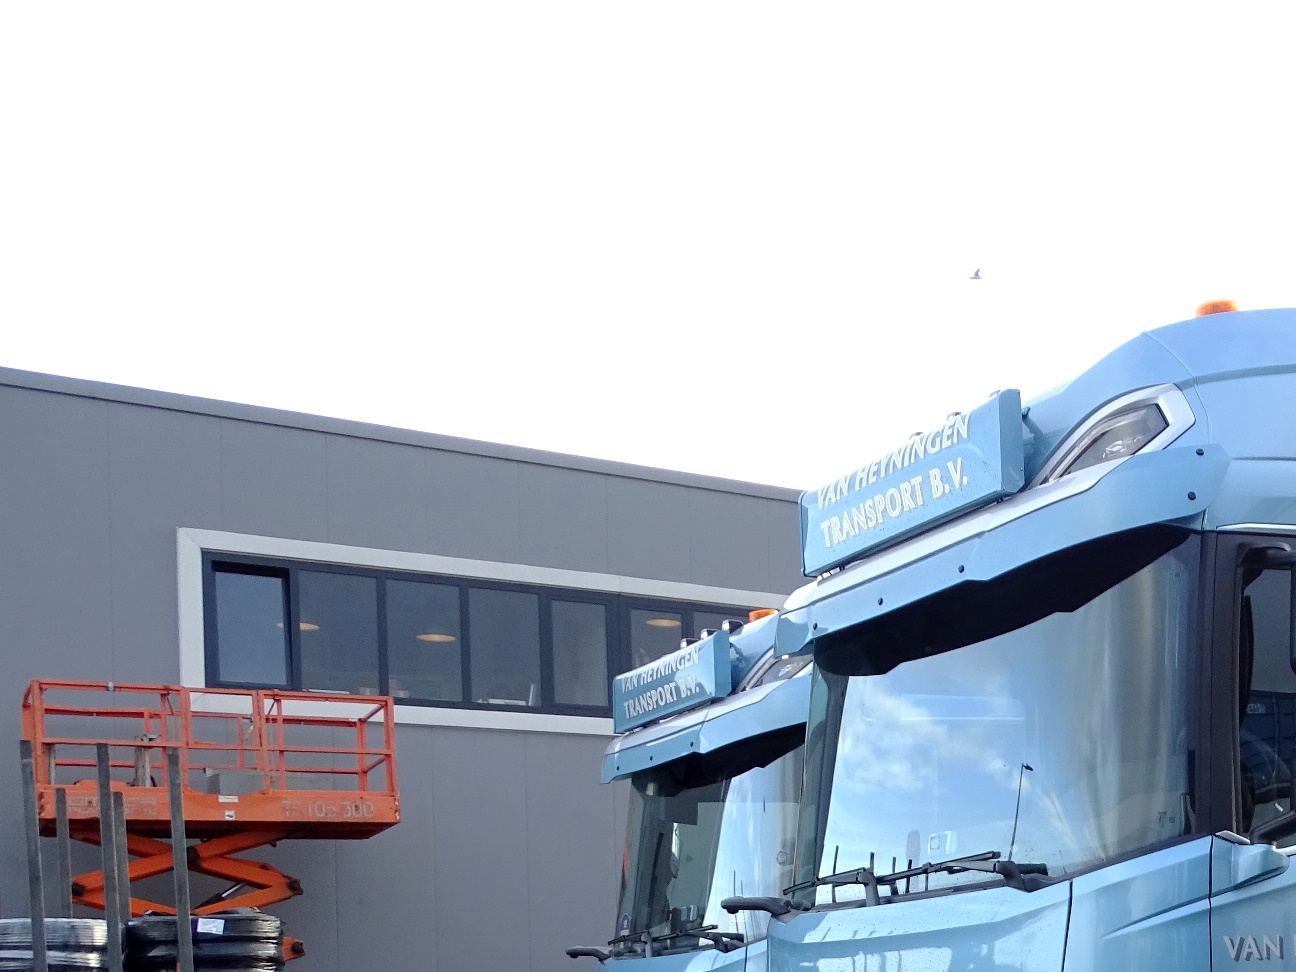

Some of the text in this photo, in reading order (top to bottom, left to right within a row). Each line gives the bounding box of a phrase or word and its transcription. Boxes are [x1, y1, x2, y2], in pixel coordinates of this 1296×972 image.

[817, 412, 971, 510] VAN HEYNINGEN
[820, 457, 968, 548] TRANSPORT B.V.
[621, 675, 638, 694] VAN
[623, 674, 700, 719] TRANSPORT B.V.
[1223, 934, 1284, 962] VAN
